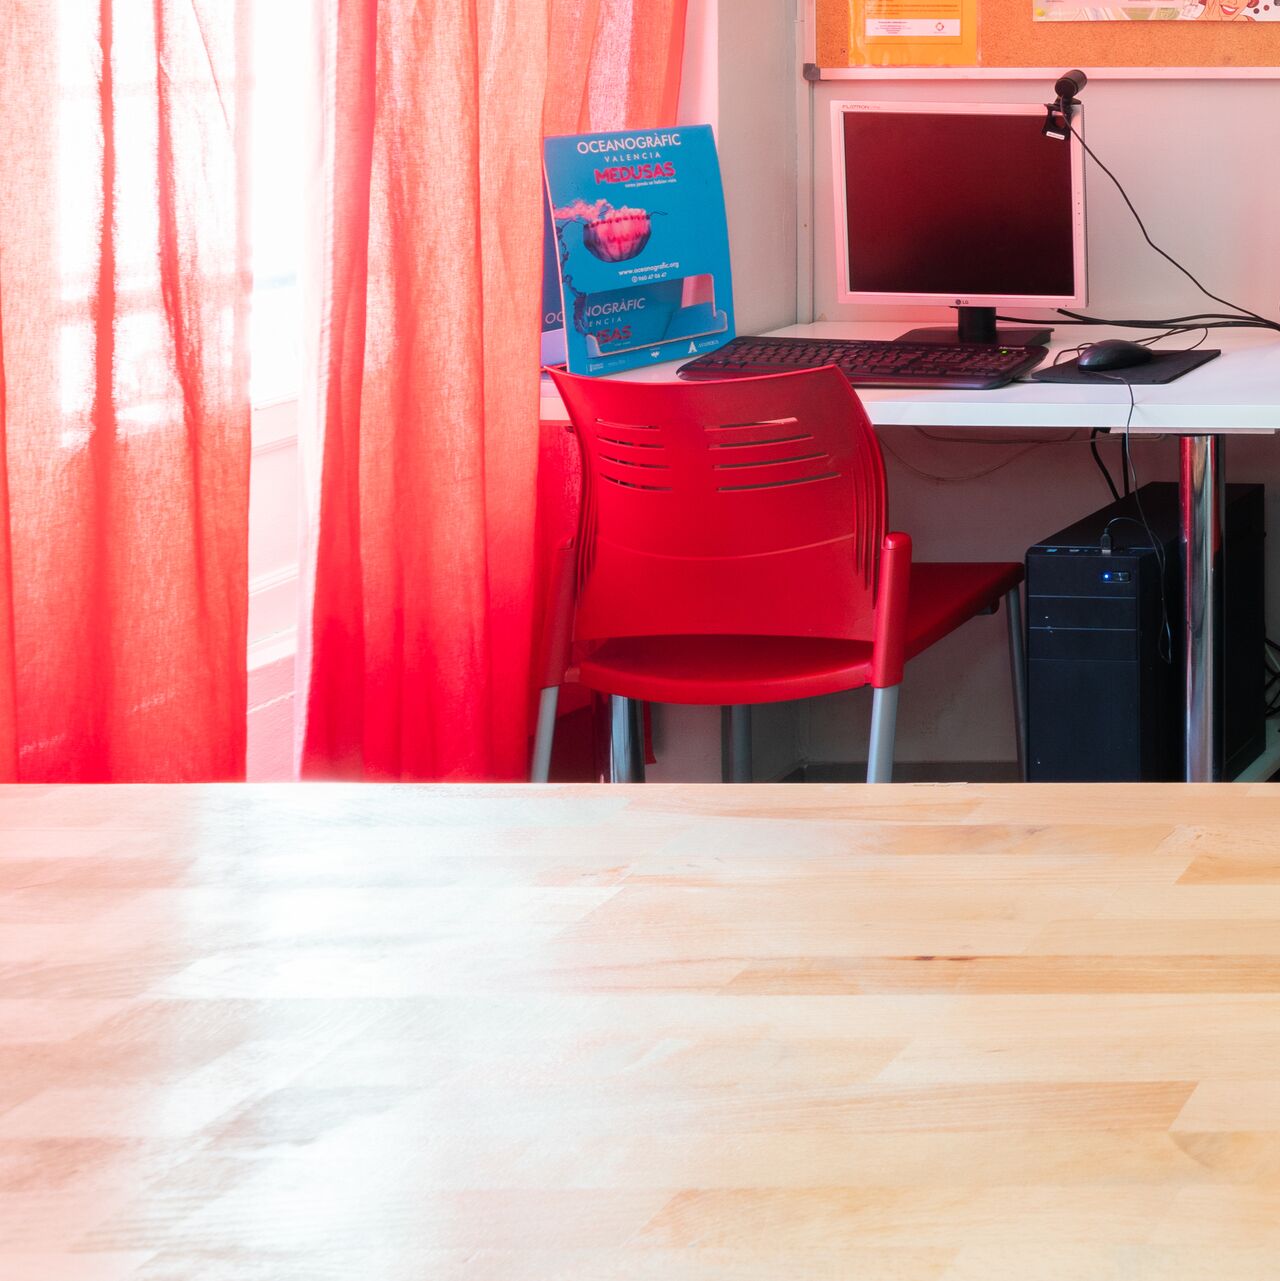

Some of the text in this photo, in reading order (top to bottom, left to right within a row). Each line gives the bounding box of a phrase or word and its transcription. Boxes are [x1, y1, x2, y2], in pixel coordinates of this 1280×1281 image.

[577, 133, 681, 154] OCEANOGRÀFIC
[604, 152, 661, 162] VALENCIA
[594, 162, 675, 185] MEDUSAS
